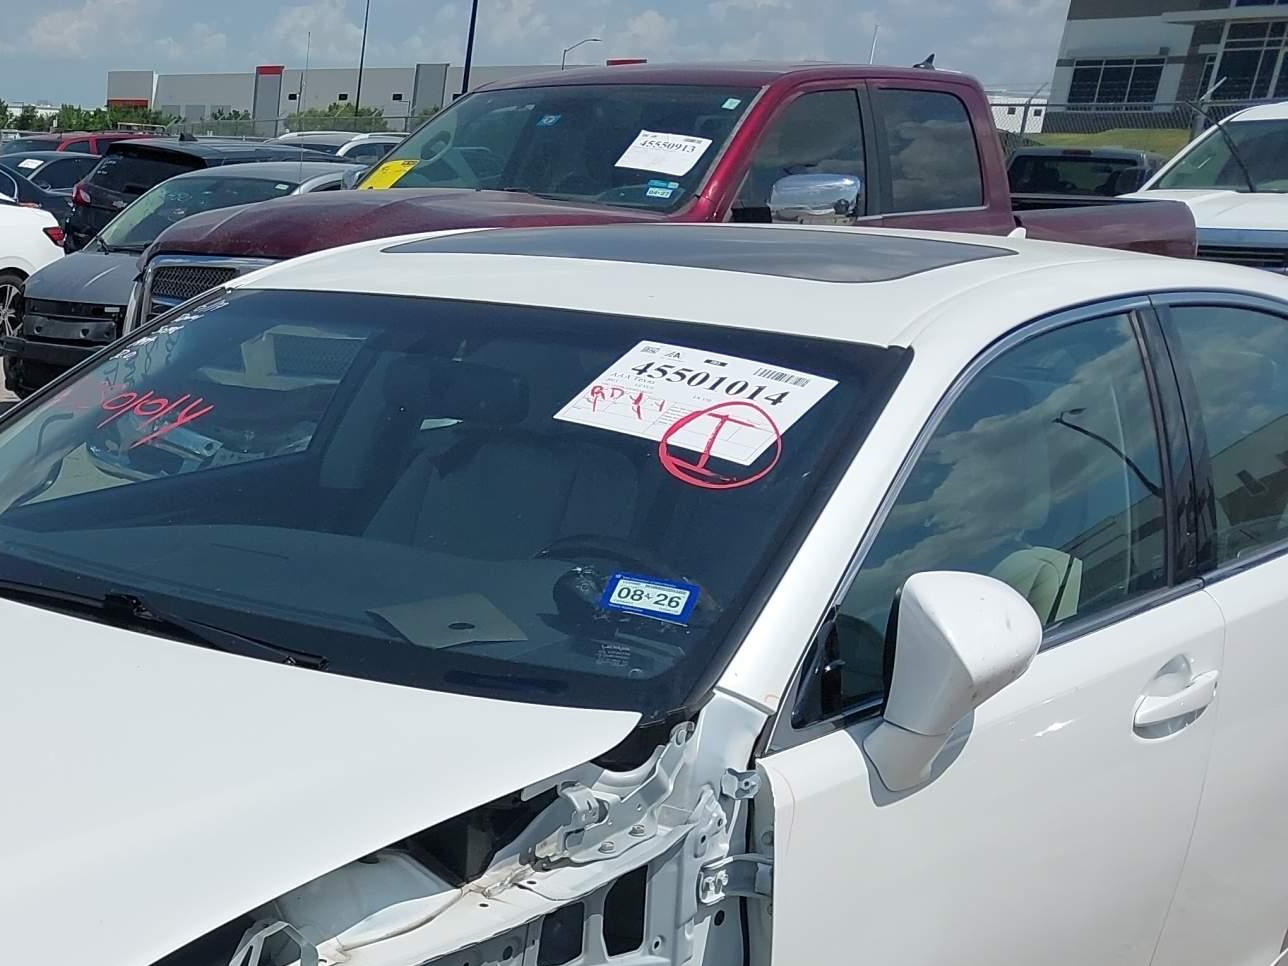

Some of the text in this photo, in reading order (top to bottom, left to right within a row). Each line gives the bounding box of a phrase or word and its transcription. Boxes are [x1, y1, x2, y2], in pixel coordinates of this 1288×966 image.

[639, 140, 695, 154] 45550913
[631, 361, 790, 406] 45501014
[617, 587, 645, 602] 08
[653, 593, 682, 609] 26
